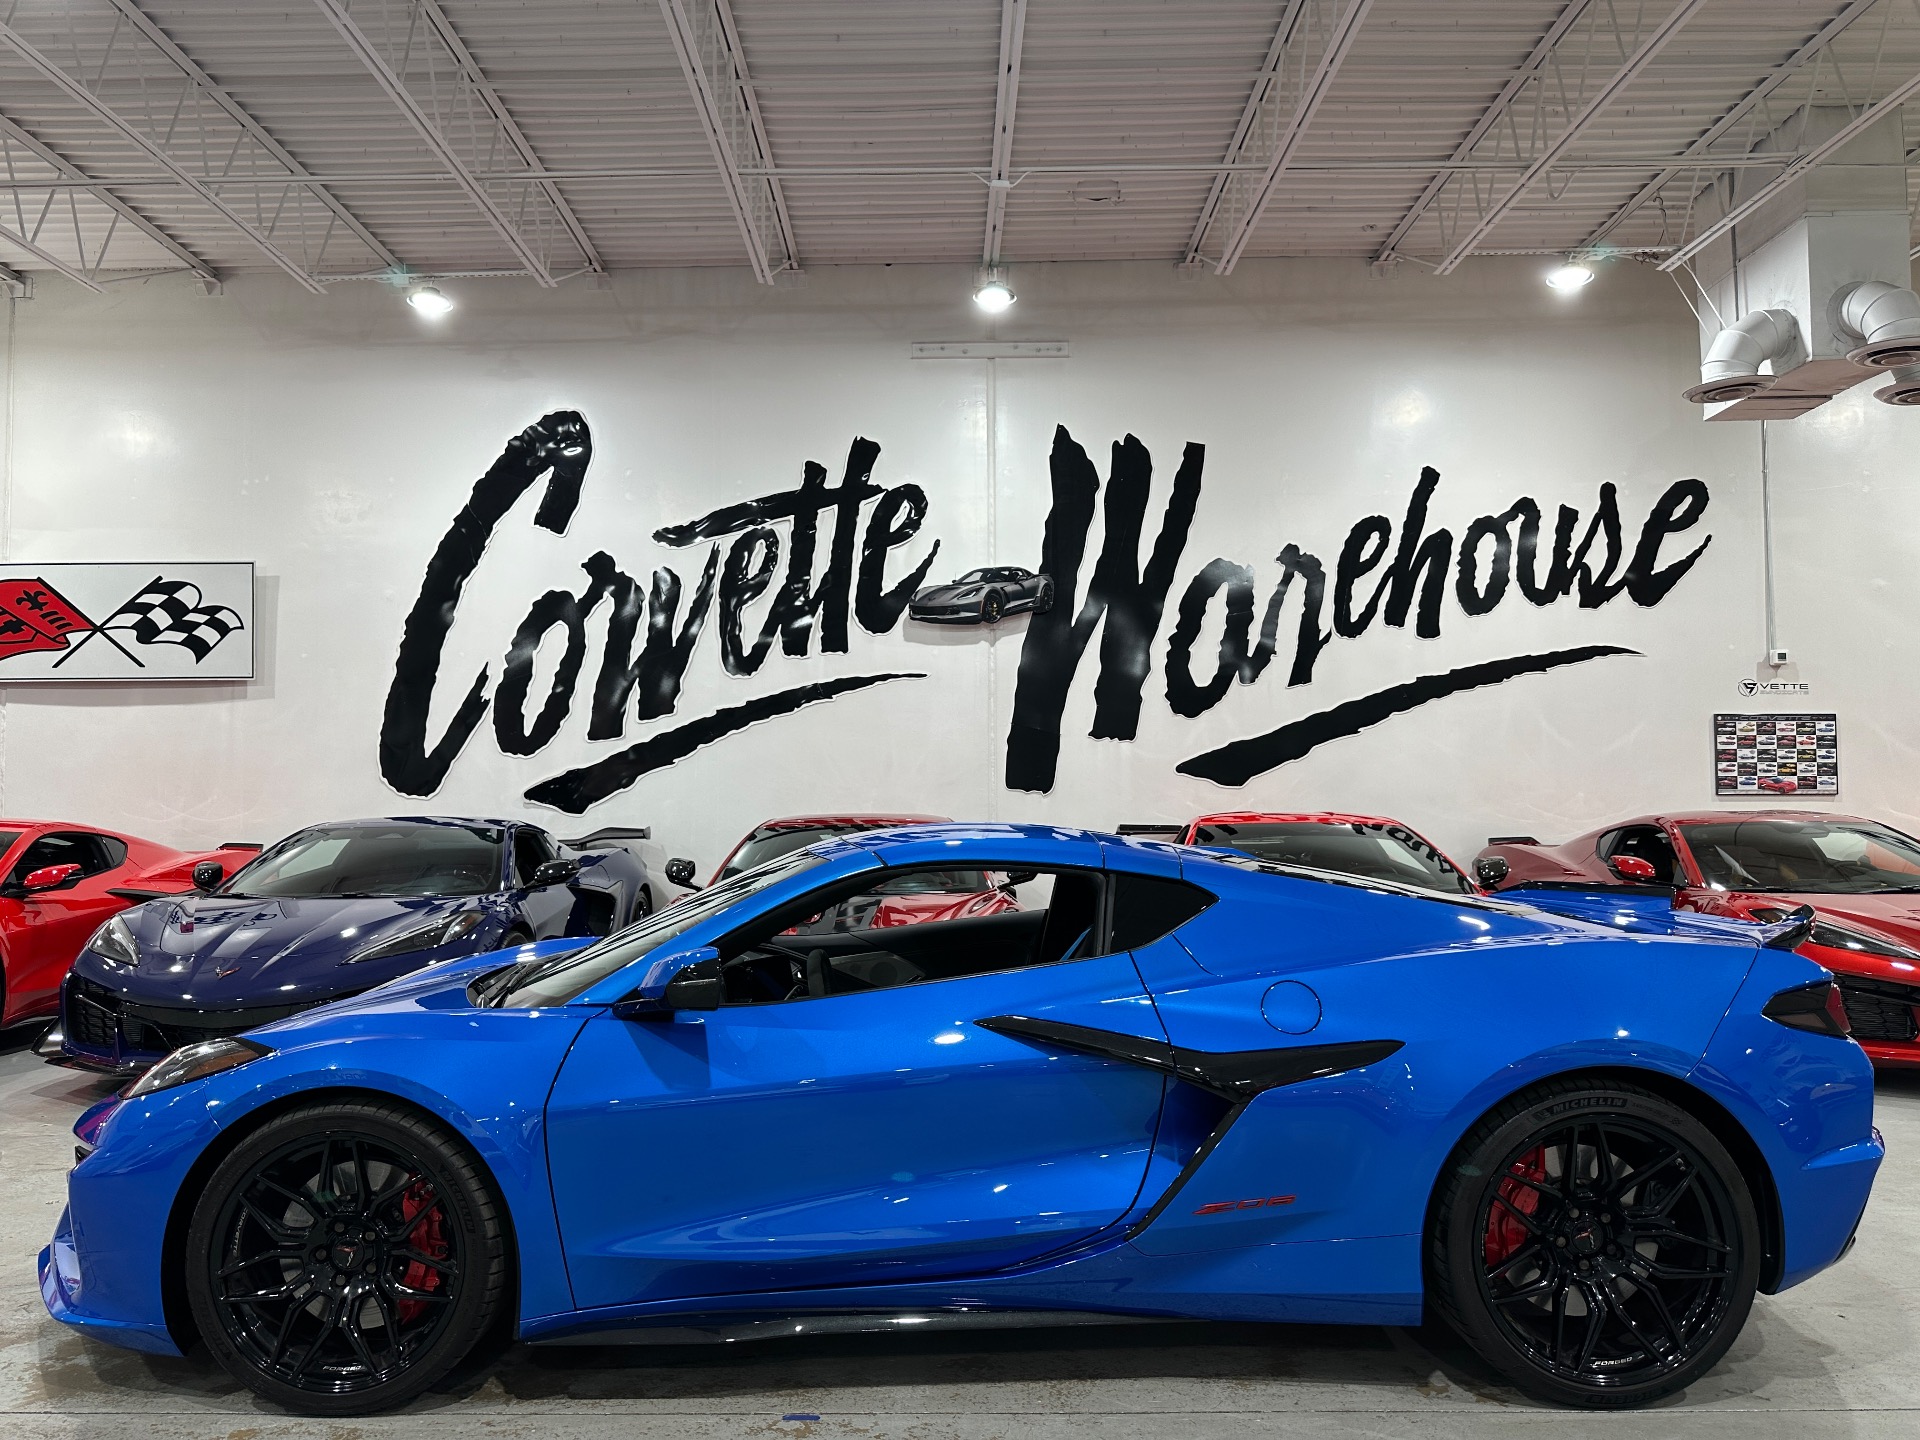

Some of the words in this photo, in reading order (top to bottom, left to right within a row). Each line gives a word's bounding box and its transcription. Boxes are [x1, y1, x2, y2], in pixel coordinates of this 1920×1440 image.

[379, 410, 939, 797] Corvette
[1005, 424, 1712, 795] Warehouse
[1552, 1097, 1625, 1113] MICHELIN
[438, 1170, 476, 1233] MICHELIN
[1192, 1194, 1296, 1215] Z06
[1594, 1356, 1633, 1366] FORGED
